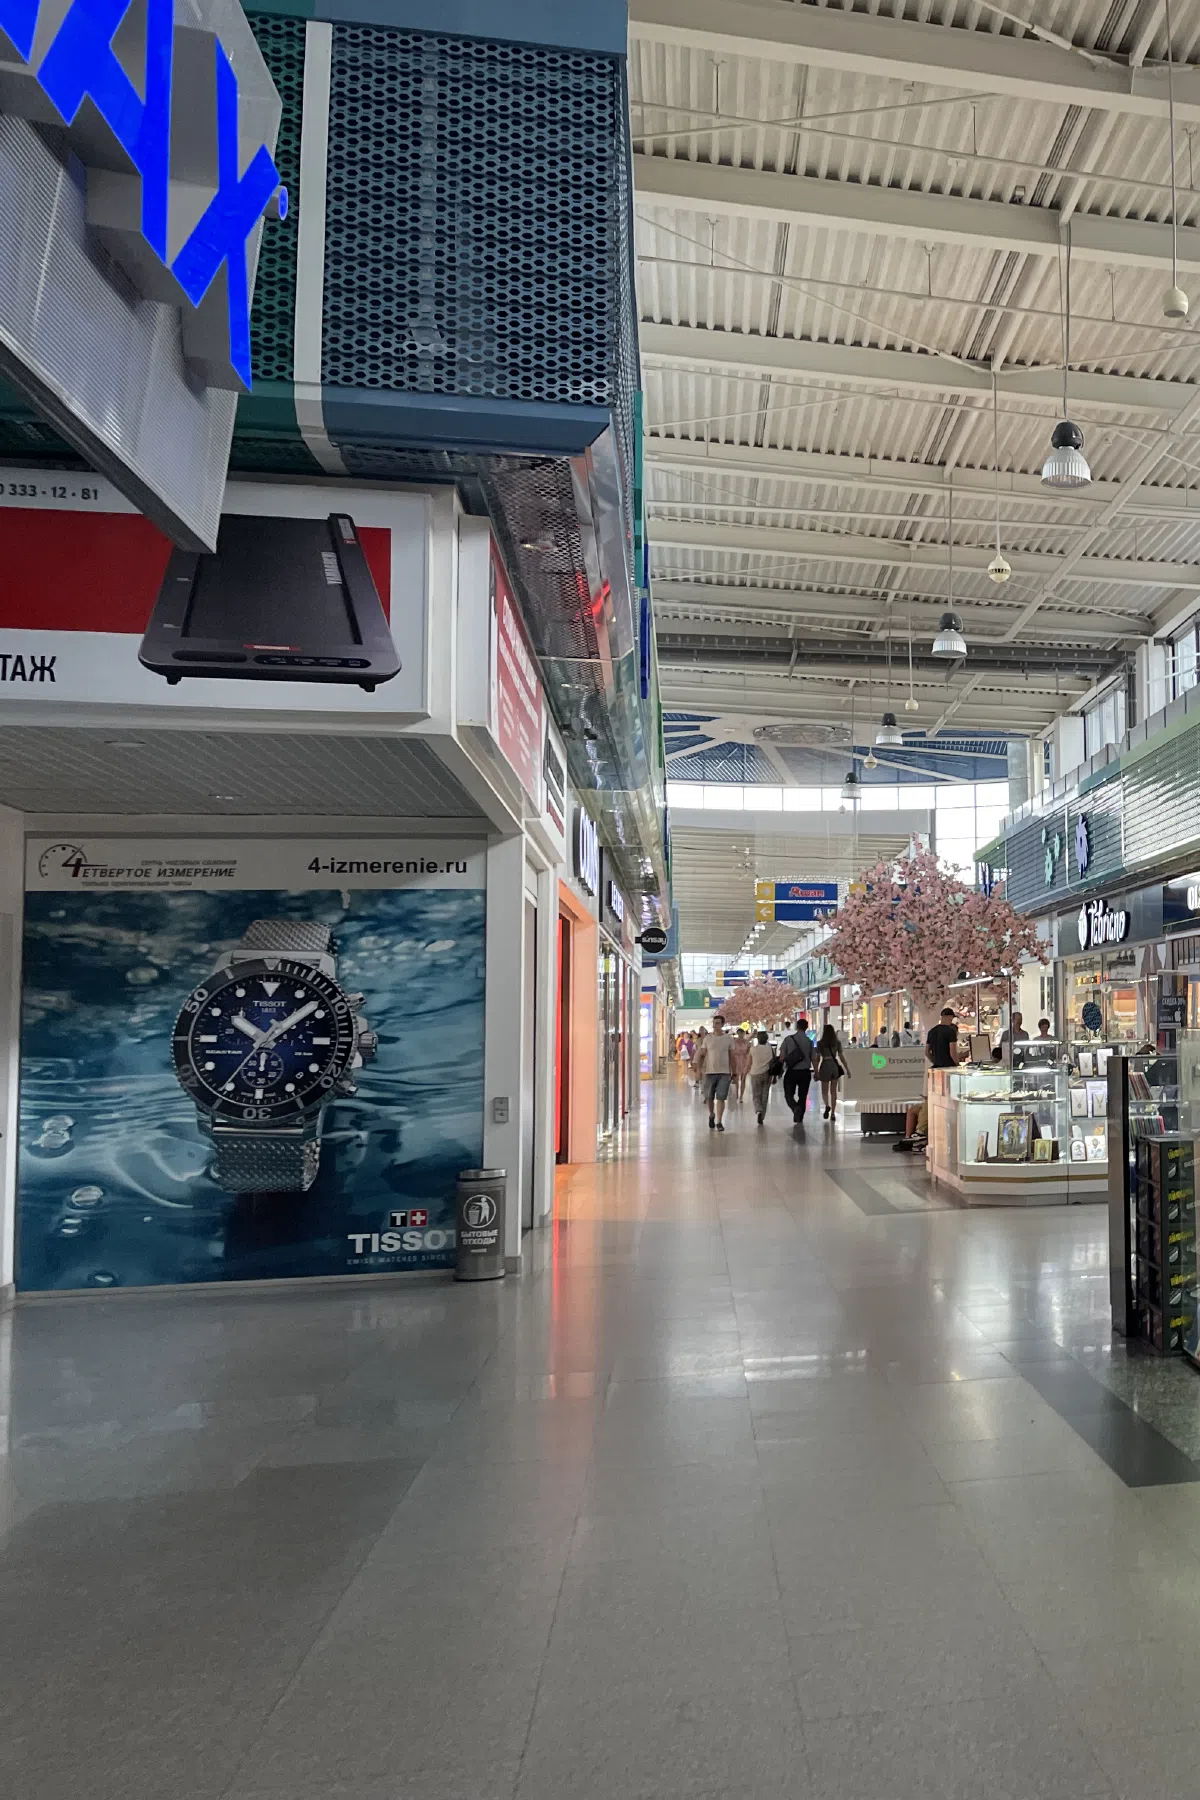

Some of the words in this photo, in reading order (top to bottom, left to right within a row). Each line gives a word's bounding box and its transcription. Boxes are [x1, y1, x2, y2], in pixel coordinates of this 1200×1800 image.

[0, 654, 57, 682] ТАЖ
[308, 857, 467, 873] 4-izmerenie.ru
[157, 867, 236, 878] ИЗМЕРЕНИЕ
[642, 936, 667, 945] sinsay
[460, 1229, 499, 1238] БЫТОВЫЕ
[462, 1236, 496, 1245] ОТХОДЫ
